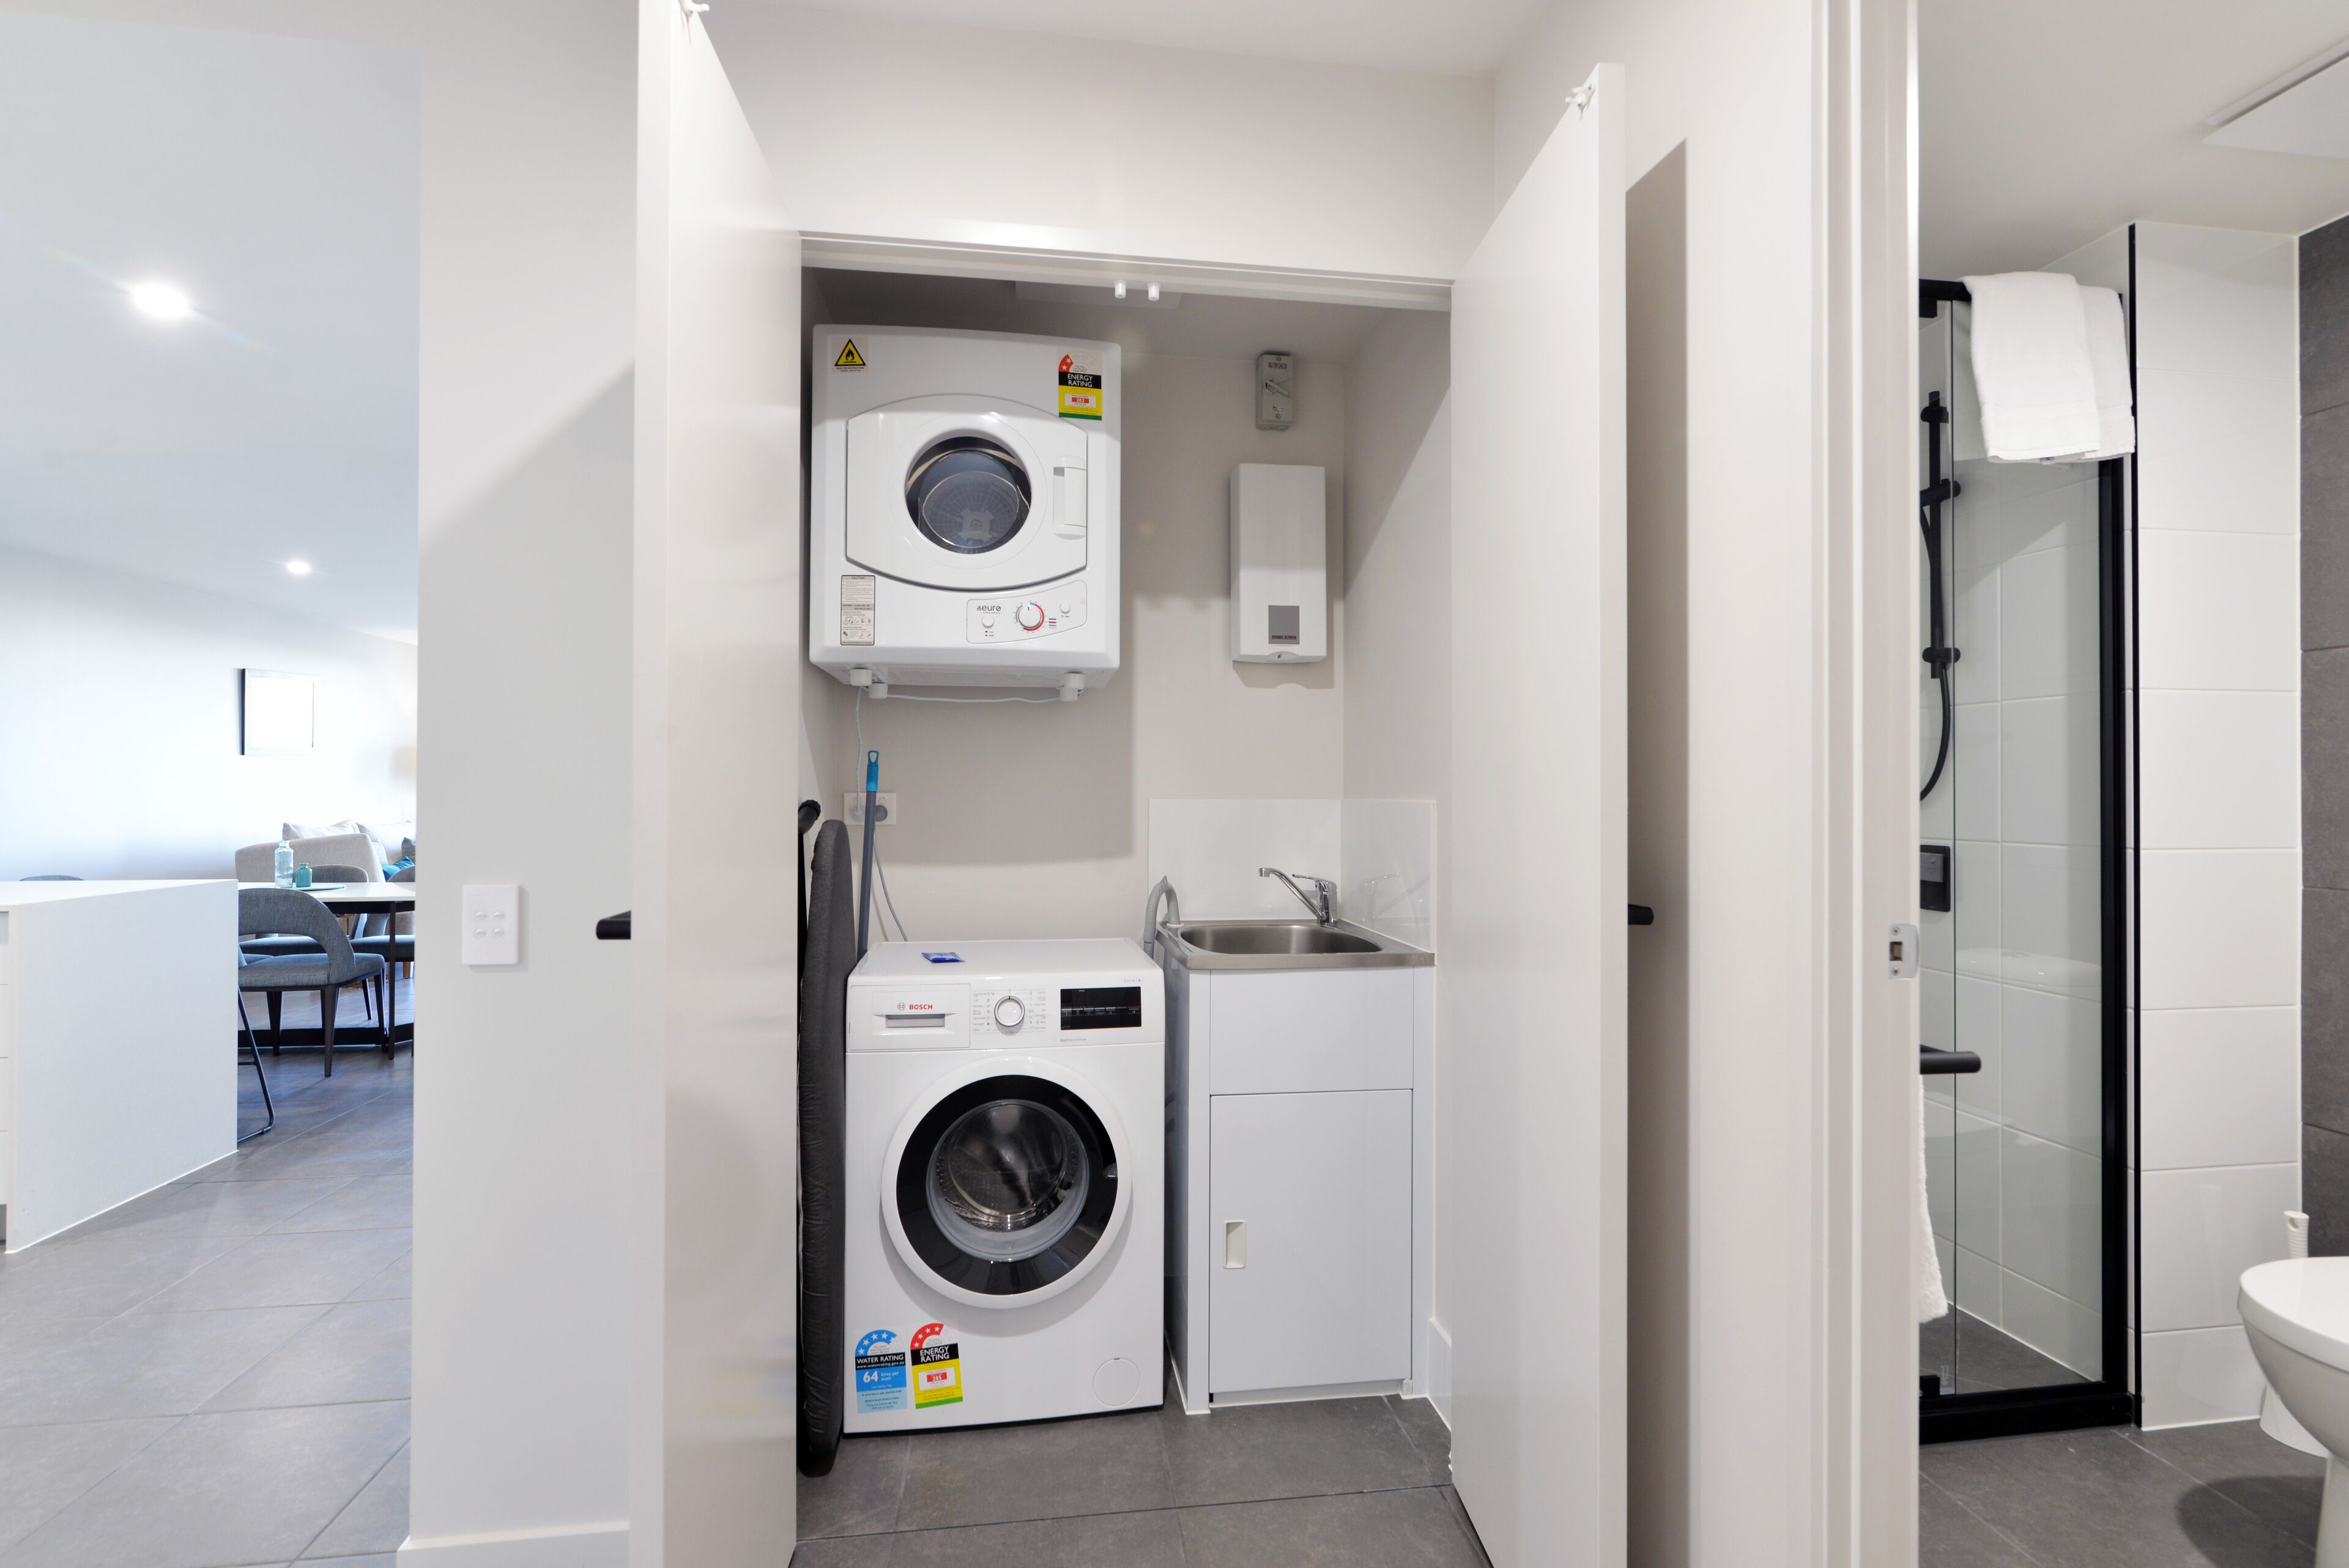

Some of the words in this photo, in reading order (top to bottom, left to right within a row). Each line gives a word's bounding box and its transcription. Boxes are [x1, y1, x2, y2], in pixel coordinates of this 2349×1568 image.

[920, 1346, 949, 1356] ENERGY
[921, 1353, 949, 1363] RATING
[863, 1370, 878, 1383] 64
